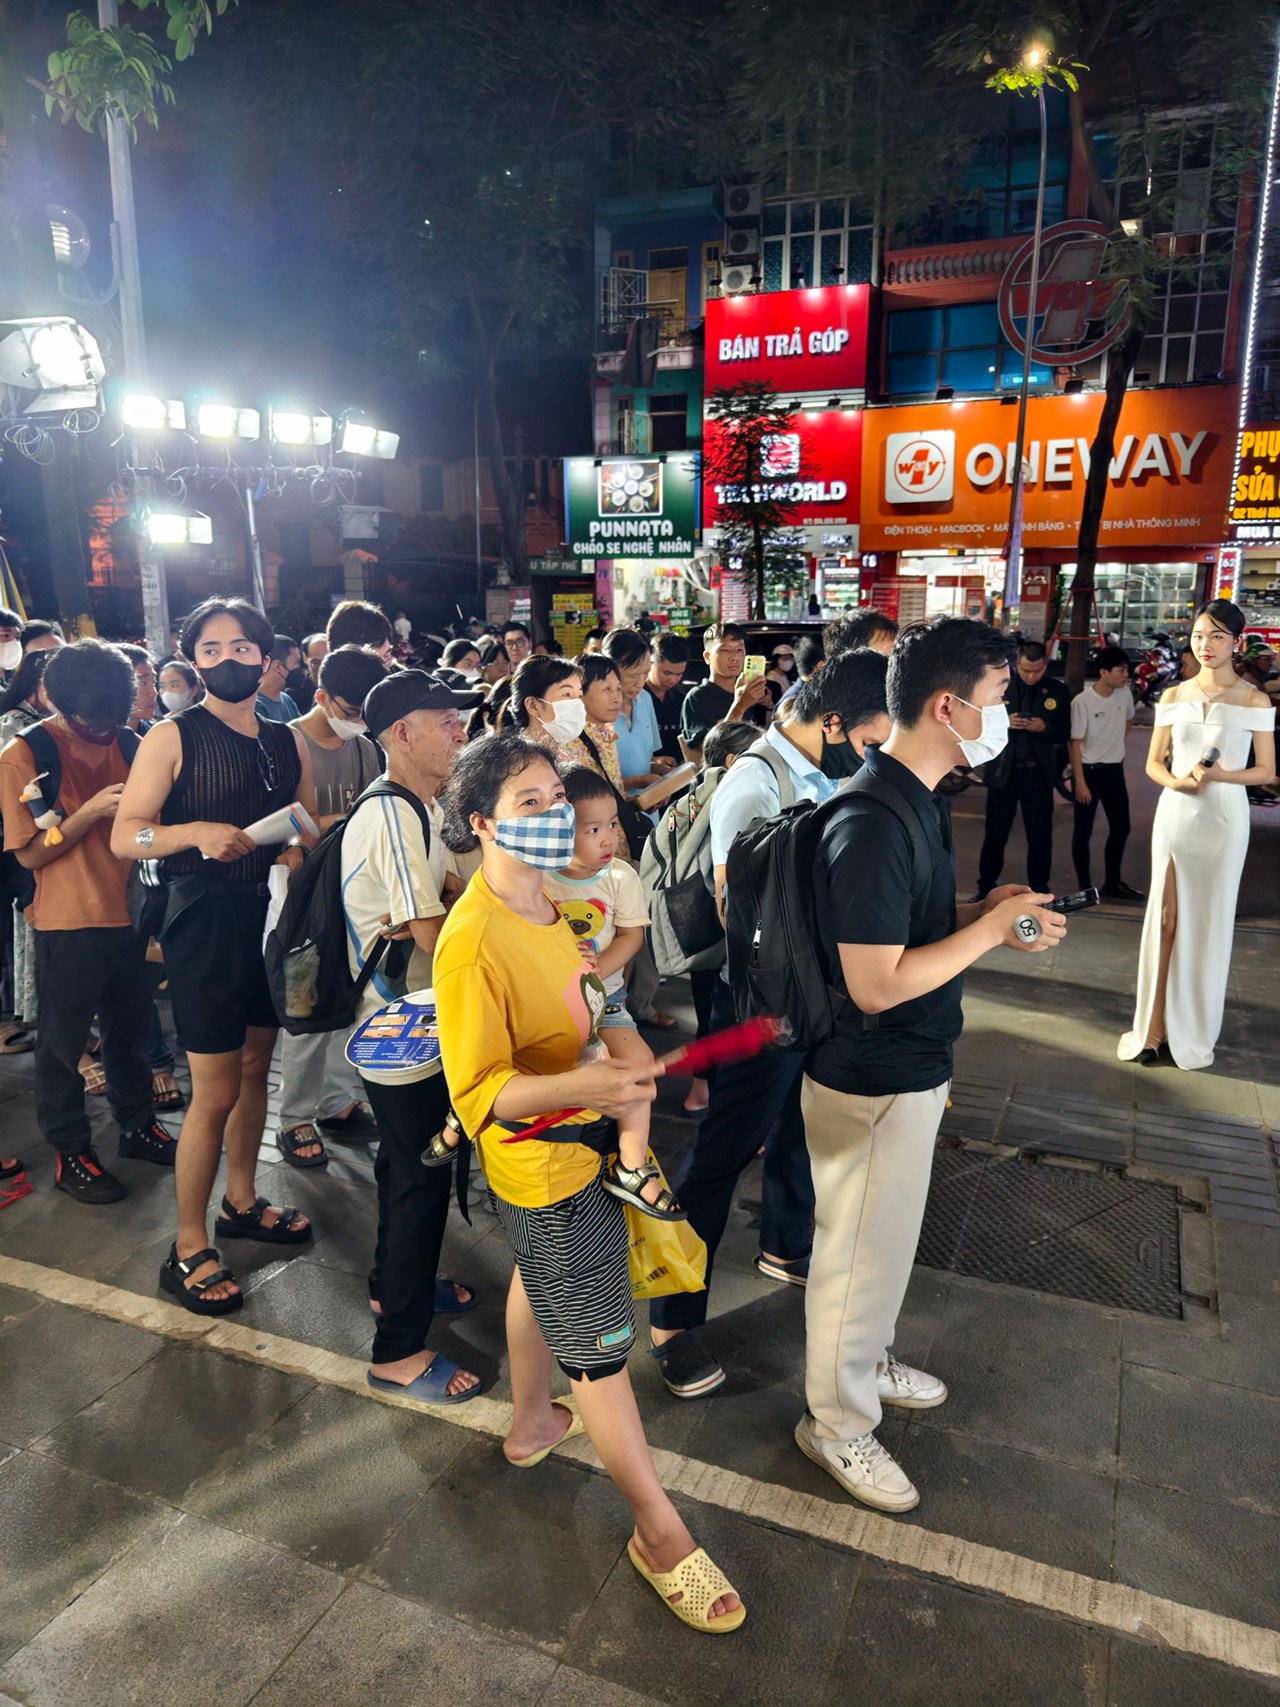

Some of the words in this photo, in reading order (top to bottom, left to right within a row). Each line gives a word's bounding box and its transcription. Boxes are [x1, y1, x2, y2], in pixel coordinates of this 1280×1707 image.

[719, 334, 760, 361] BÁN
[764, 326, 803, 357] TRẢ
[808, 326, 849, 355] GÓP
[1235, 465, 1275, 502] SỬA
[589, 519, 673, 538] PUNNATA
[905, 524, 933, 536] THOẠI
[940, 523, 985, 534] MACBOOK
[1136, 516, 1173, 528] THÔNG
[1174, 517, 1201, 527] MINH
[1236, 526, 1270, 538] MUA
[573, 538, 605, 555] CHÁO
[606, 541, 622, 554] SE
[623, 537, 655, 557] NGHỆ
[658, 537, 691, 554] NHÂN
[1020, 919, 1037, 937] 50
